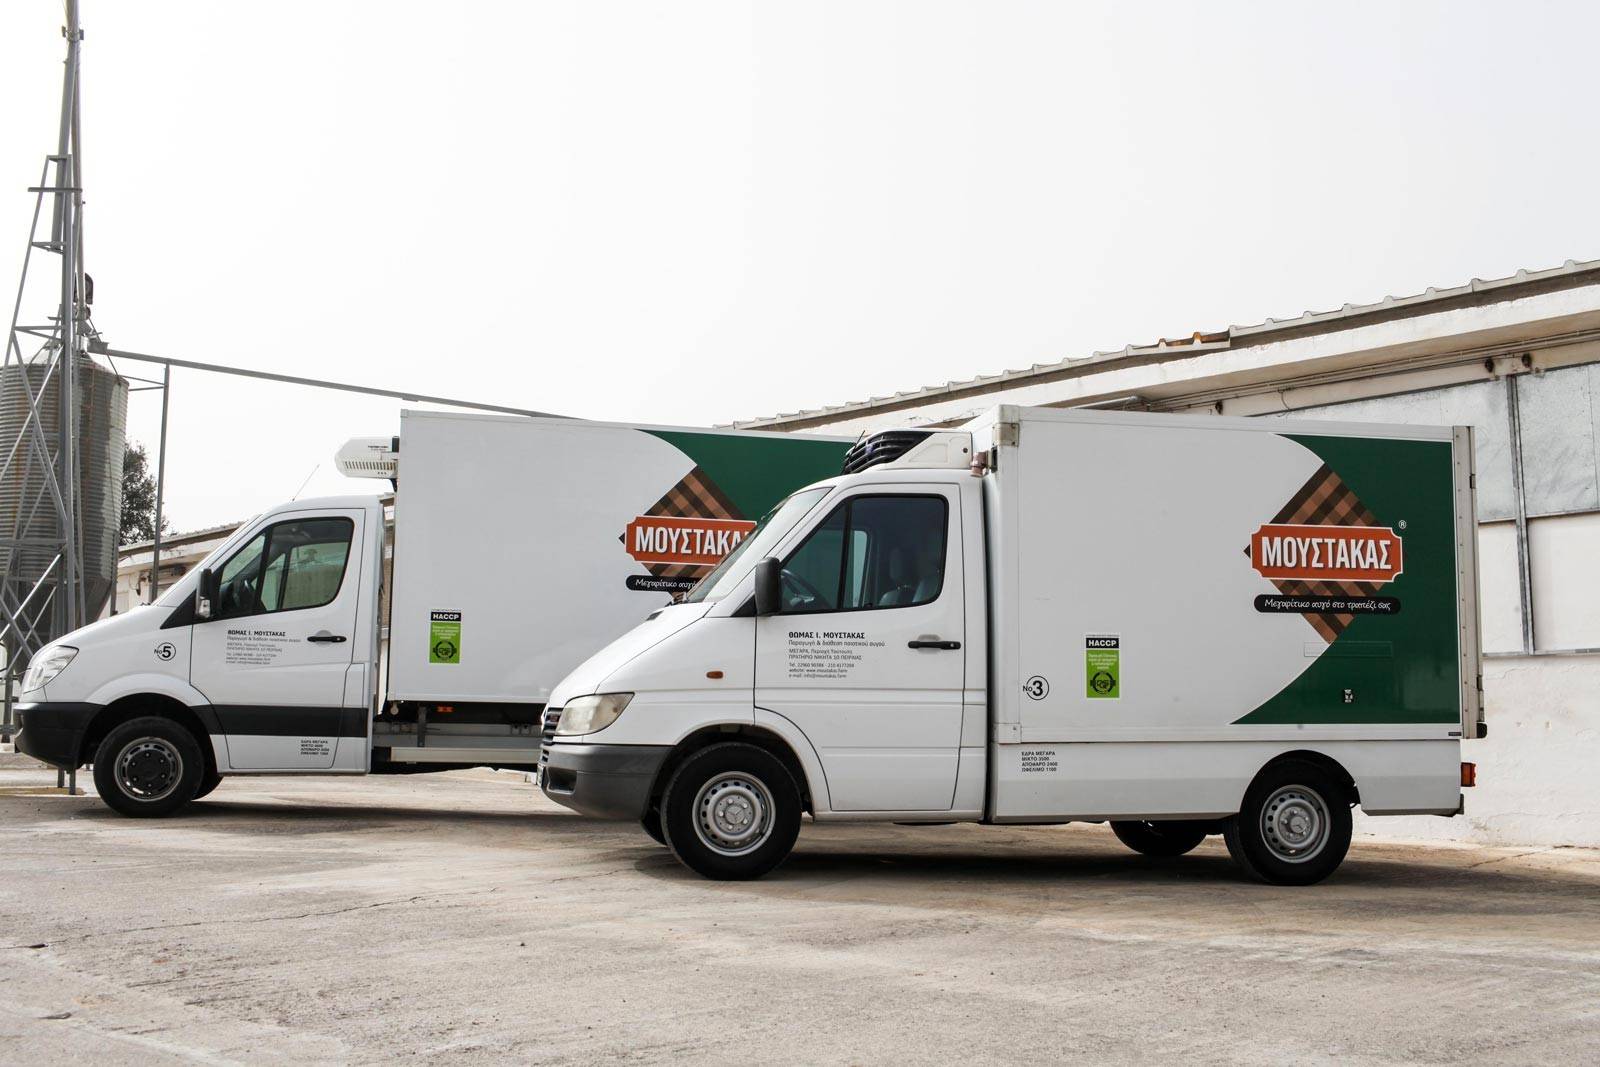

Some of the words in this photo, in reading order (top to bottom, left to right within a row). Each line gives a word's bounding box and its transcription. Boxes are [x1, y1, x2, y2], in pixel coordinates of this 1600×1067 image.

[635, 525, 750, 556] ΜΟΥΣΤΑΚΑ
[1261, 536, 1392, 569] ΜΟΥΣΤΑΚΑΣ
[1264, 598, 1310, 610] Μεγαρίτικο
[1311, 599, 1331, 610] αυγό
[1347, 599, 1377, 611] τραπέζι
[1378, 602, 1391, 610] σας
[788, 631, 814, 639] ΘΩΜΑΣ
